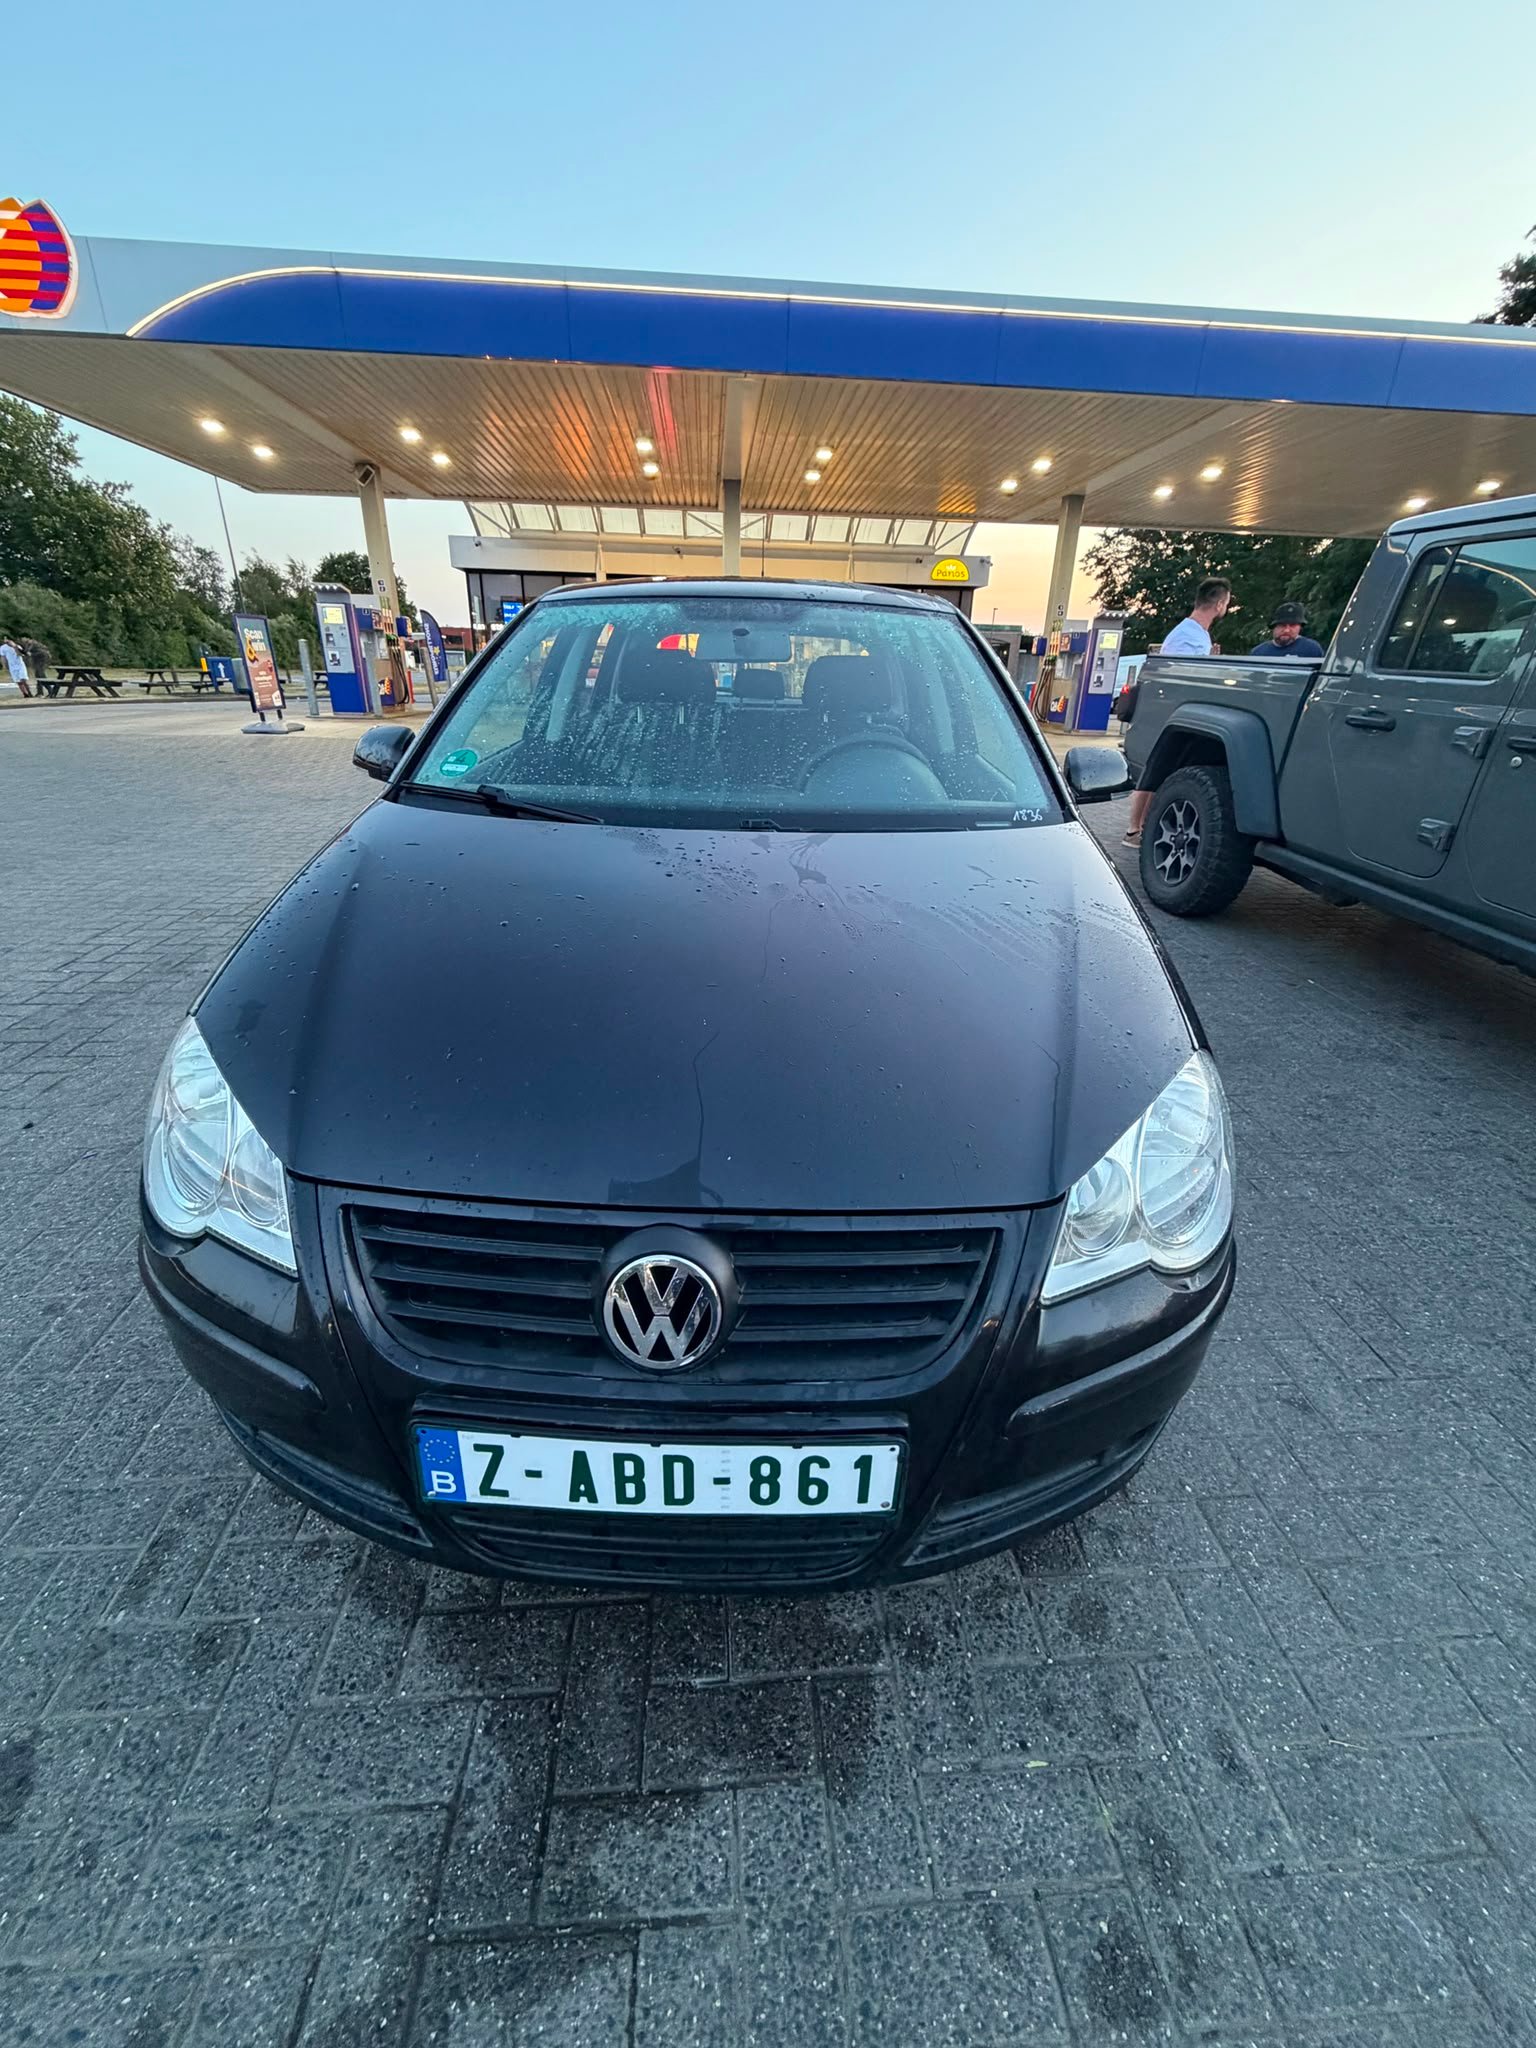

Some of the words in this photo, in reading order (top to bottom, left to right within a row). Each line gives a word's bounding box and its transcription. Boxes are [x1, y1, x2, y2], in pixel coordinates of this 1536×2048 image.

[936, 569, 966, 578] Panos
[243, 628, 264, 640] Scan
[1013, 808, 1043, 822] 1836
[473, 1443, 873, 1506] Z-ABD-861
[431, 1470, 457, 1494] B
